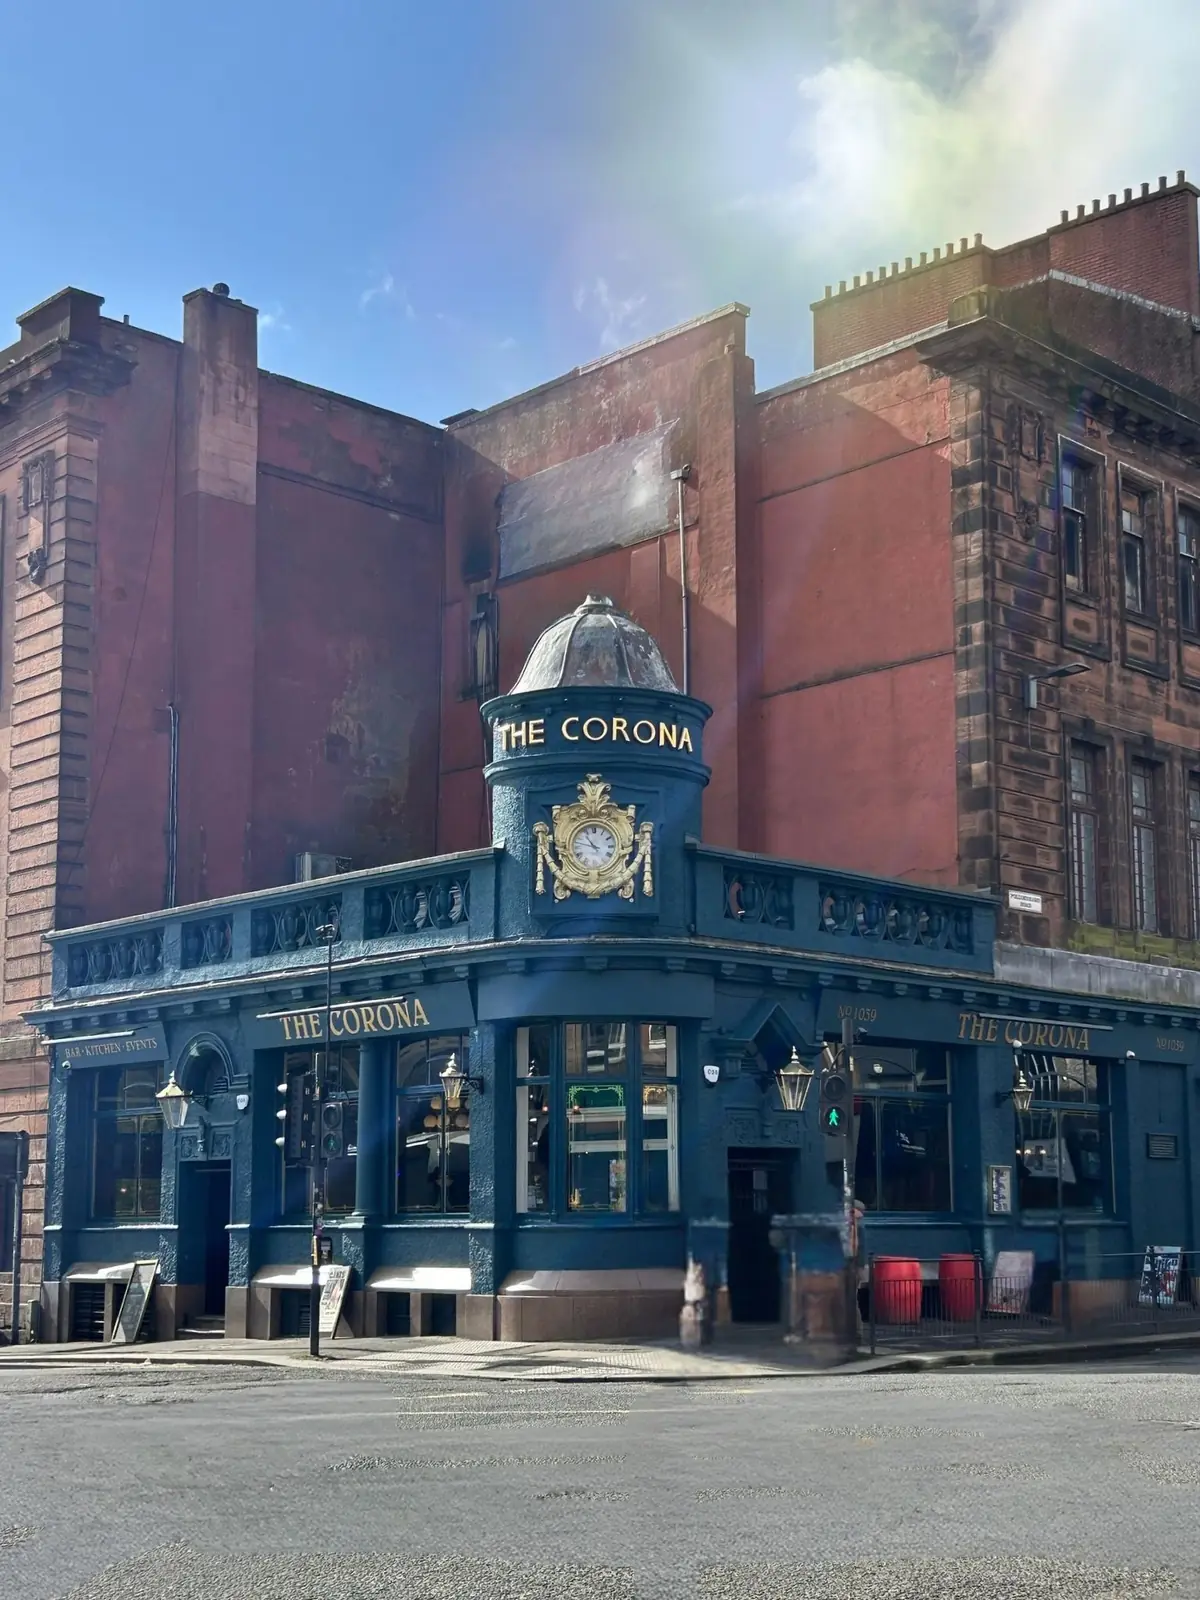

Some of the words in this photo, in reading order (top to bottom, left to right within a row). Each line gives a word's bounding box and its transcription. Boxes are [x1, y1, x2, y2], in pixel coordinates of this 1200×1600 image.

[499, 718, 545, 751] THE
[561, 716, 693, 752] CORONA
[279, 1013, 323, 1040] THE
[329, 998, 430, 1036] CORONA
[958, 1013, 999, 1042] THE
[1004, 1020, 1089, 1051] CORONA
[64, 1047, 81, 1058] BAR
[85, 1042, 121, 1056] KITCHEN
[125, 1037, 158, 1052] EVENTS
